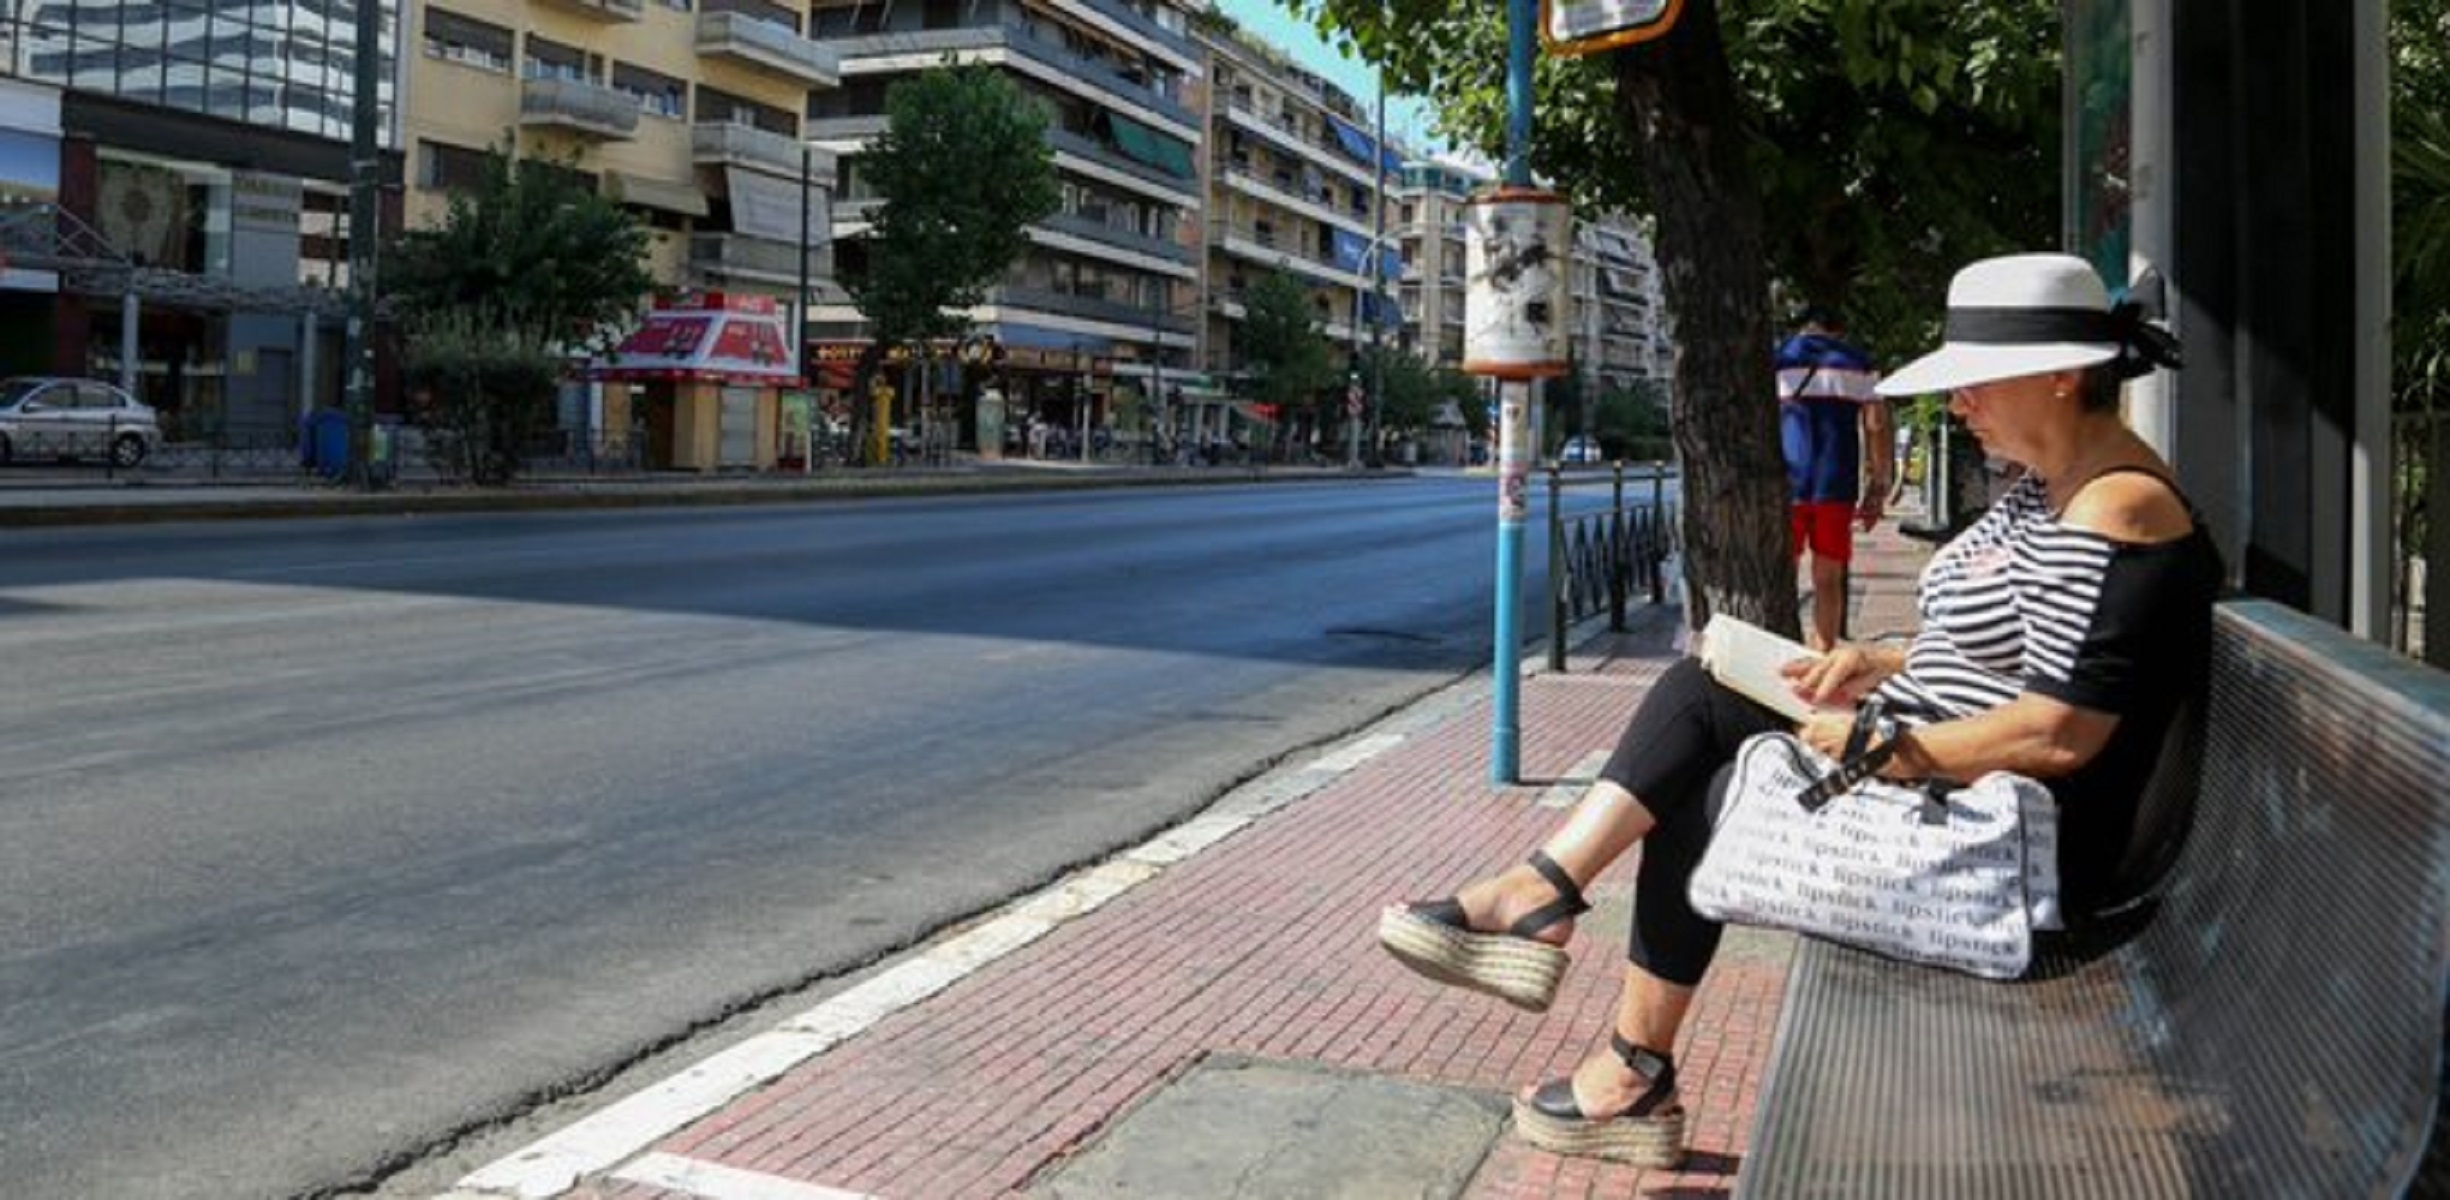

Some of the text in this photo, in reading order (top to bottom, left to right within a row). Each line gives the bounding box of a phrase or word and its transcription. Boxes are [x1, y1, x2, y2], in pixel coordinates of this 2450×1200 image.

[1839, 822, 1920, 847] lipsck
[1832, 865, 1917, 892] lipstick
[1797, 879, 1877, 911] lipstick
[1828, 911, 1914, 940] lipstick
[1930, 929, 2019, 955] lipstick
